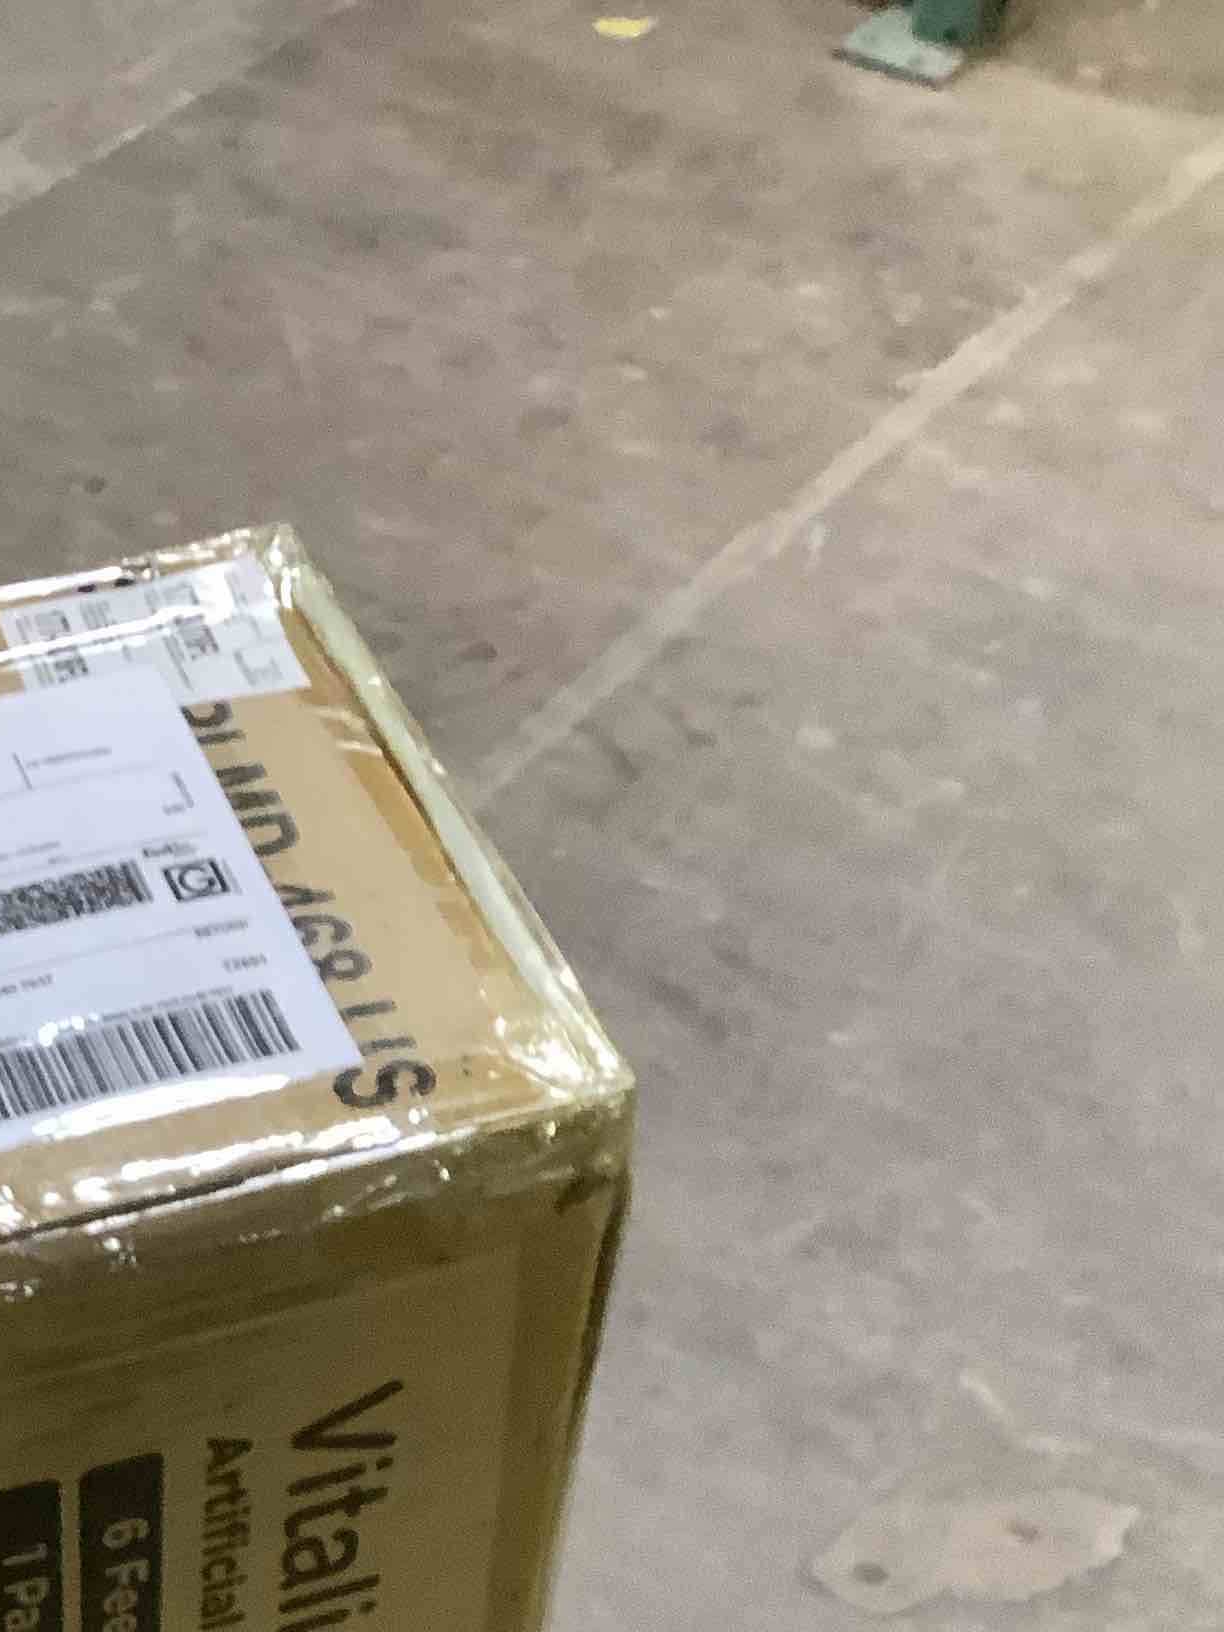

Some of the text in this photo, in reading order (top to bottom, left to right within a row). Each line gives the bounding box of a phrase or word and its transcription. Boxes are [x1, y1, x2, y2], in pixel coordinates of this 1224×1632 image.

[103, 1517, 150, 1549] 6
[199, 1437, 253, 1631] Artificial
[2, 1542, 48, 1567] 1
